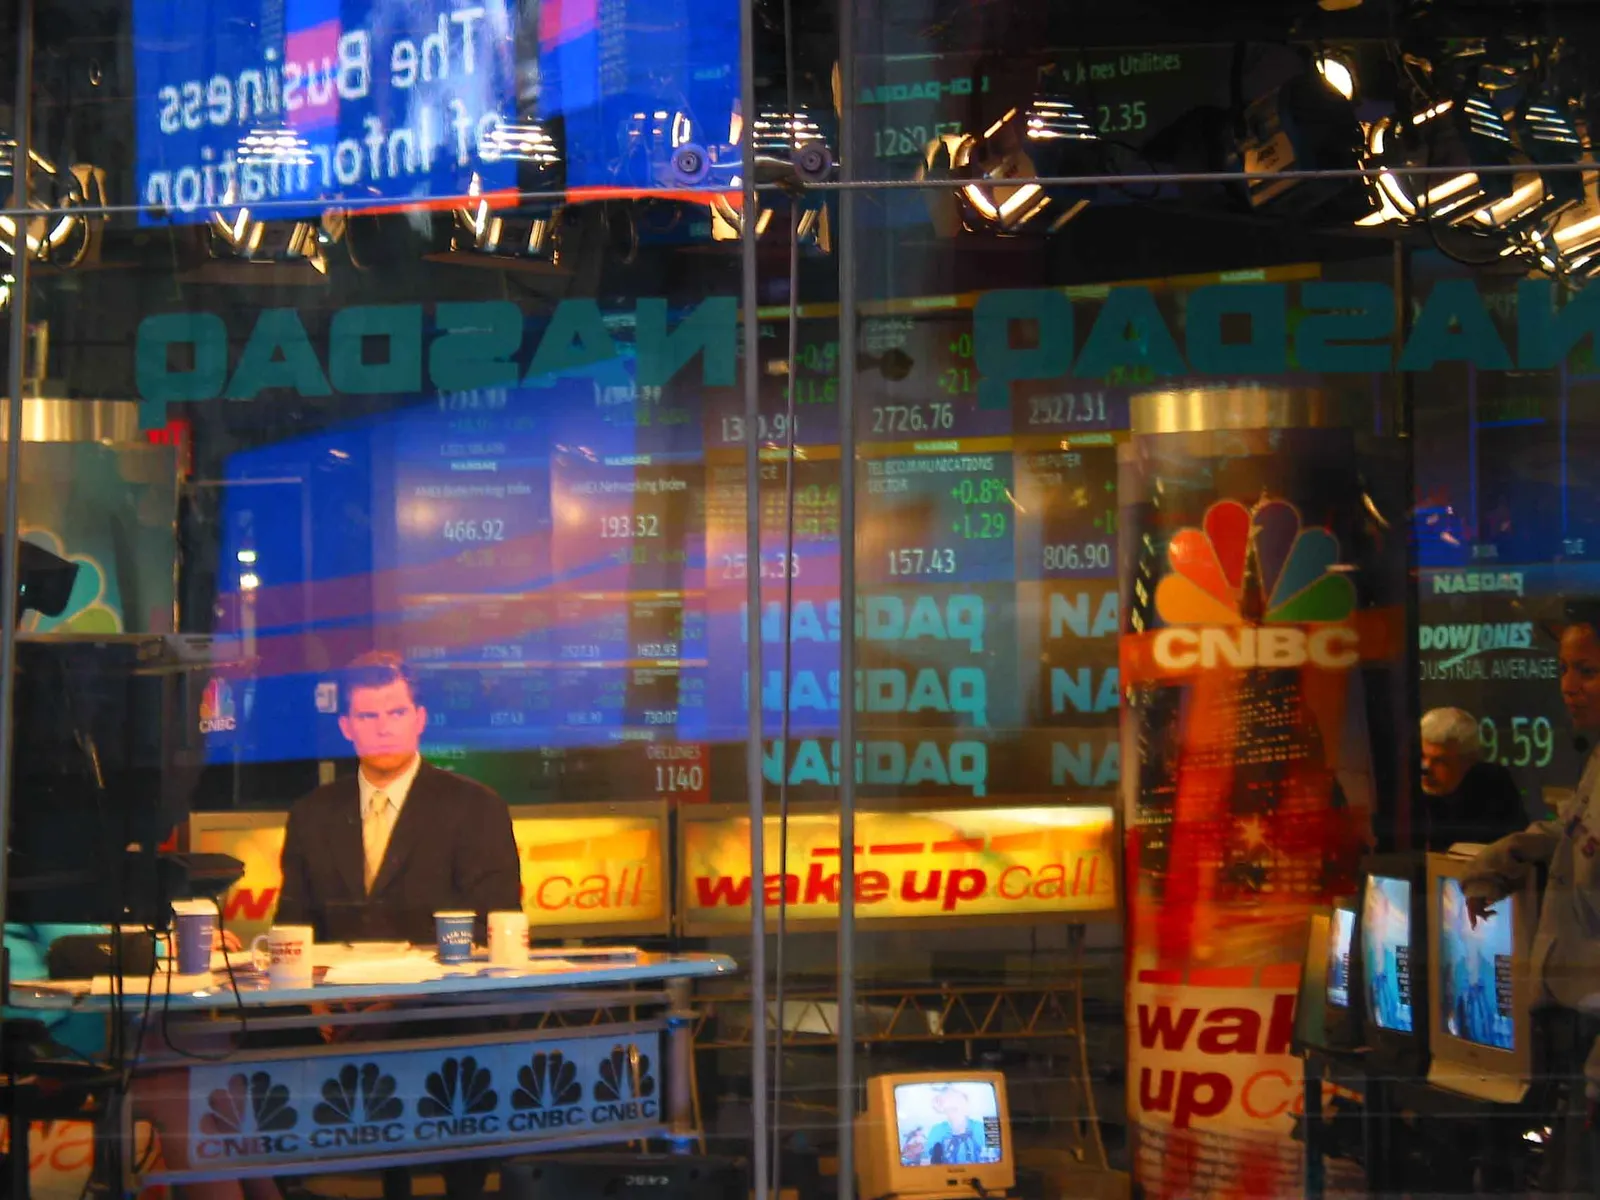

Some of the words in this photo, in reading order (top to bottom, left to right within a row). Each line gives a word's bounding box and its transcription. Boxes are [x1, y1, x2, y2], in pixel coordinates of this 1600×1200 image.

[1119, 53, 1181, 75] Utilities
[872, 402, 955, 433] 2726.76
[443, 519, 505, 544] 466.92
[600, 515, 659, 538] 193.32
[951, 512, 1006, 540] +1.29
[888, 548, 957, 576] 157.43
[1043, 543, 1110, 571] 806.90
[1153, 627, 1360, 669] CNBC
[1492, 656, 1558, 680] AVERAGE
[655, 765, 702, 792] 1140
[536, 866, 644, 911] call
[695, 862, 889, 908] wake
[901, 867, 987, 911] up
[998, 856, 1099, 901] call
[1139, 1066, 1233, 1130] up
[197, 1133, 298, 1160] CNBC
[310, 1121, 406, 1148] CNBC
[413, 1115, 500, 1142] CNBC
[507, 1106, 586, 1133] CNBC
[591, 1100, 657, 1124] CNBC
